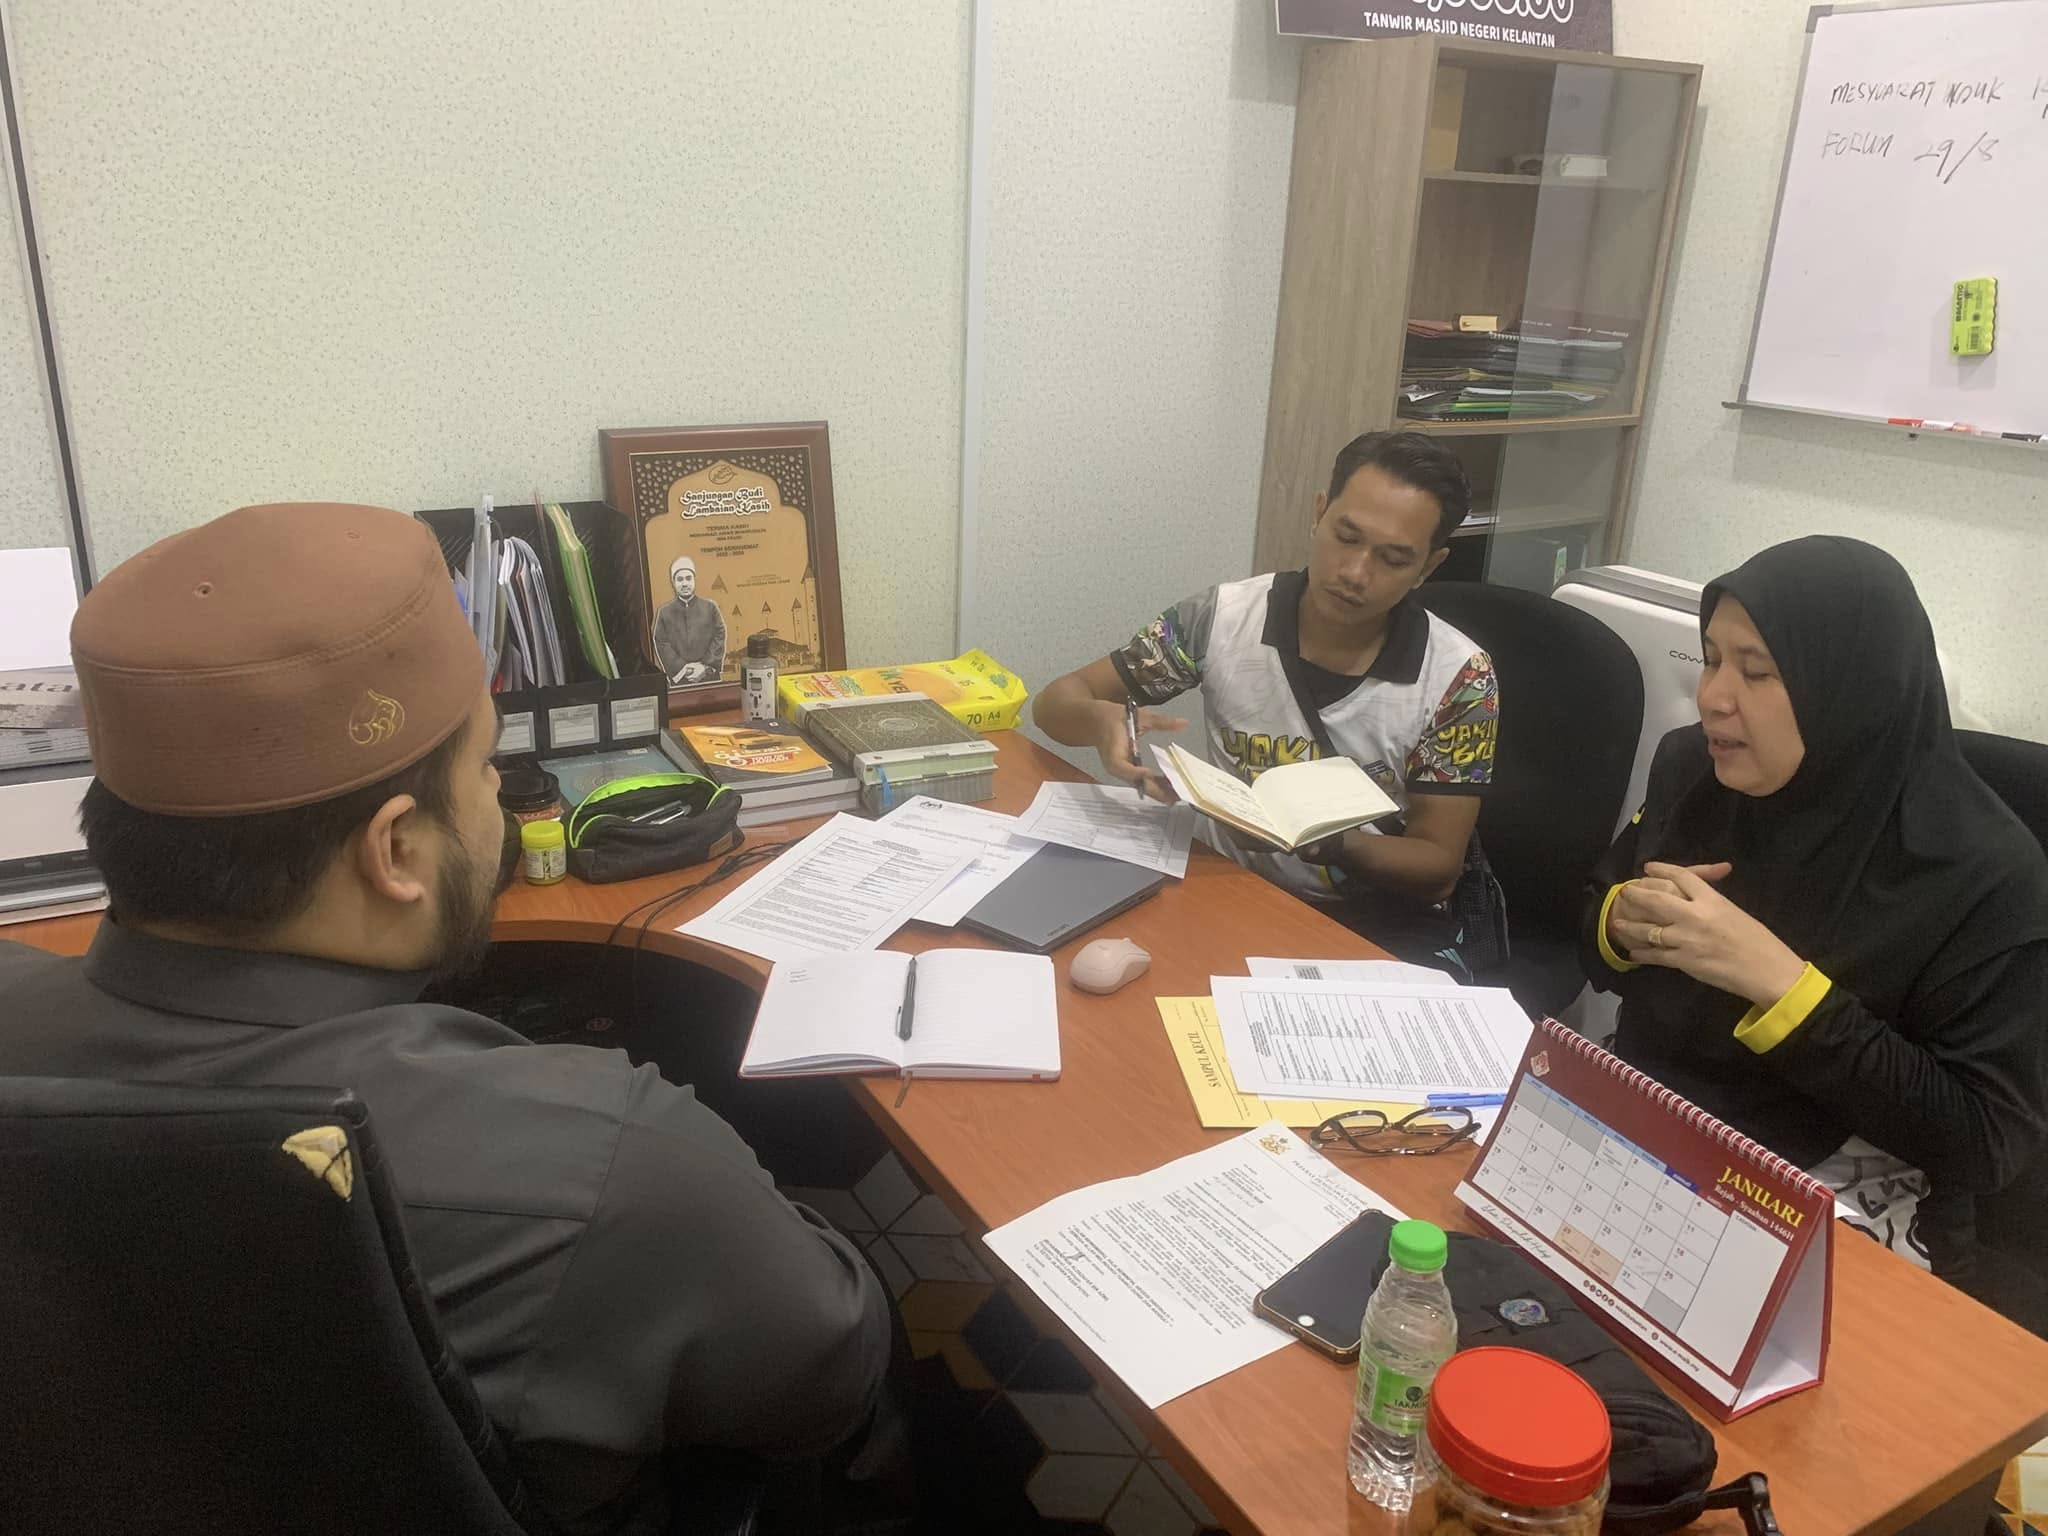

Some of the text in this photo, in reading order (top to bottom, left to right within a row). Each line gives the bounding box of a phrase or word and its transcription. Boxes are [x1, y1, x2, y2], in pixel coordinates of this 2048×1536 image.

[1363, 11, 1412, 30] TANWIR
[1415, 17, 1458, 35] MASJID
[1460, 24, 1500, 39] NEGERI
[1502, 29, 1555, 48] KELANTAN
[680, 487, 764, 503] Sanjungan Budi
[681, 500, 771, 519] Lambaian Kasih
[1669, 650, 1704, 664] COW
[966, 711, 1001, 725] 70 A4
[1198, 1056, 1222, 1088] SAMPUL
[1714, 1184, 1735, 1202] Rejab
[1717, 1166, 1805, 1228] JANUARI
